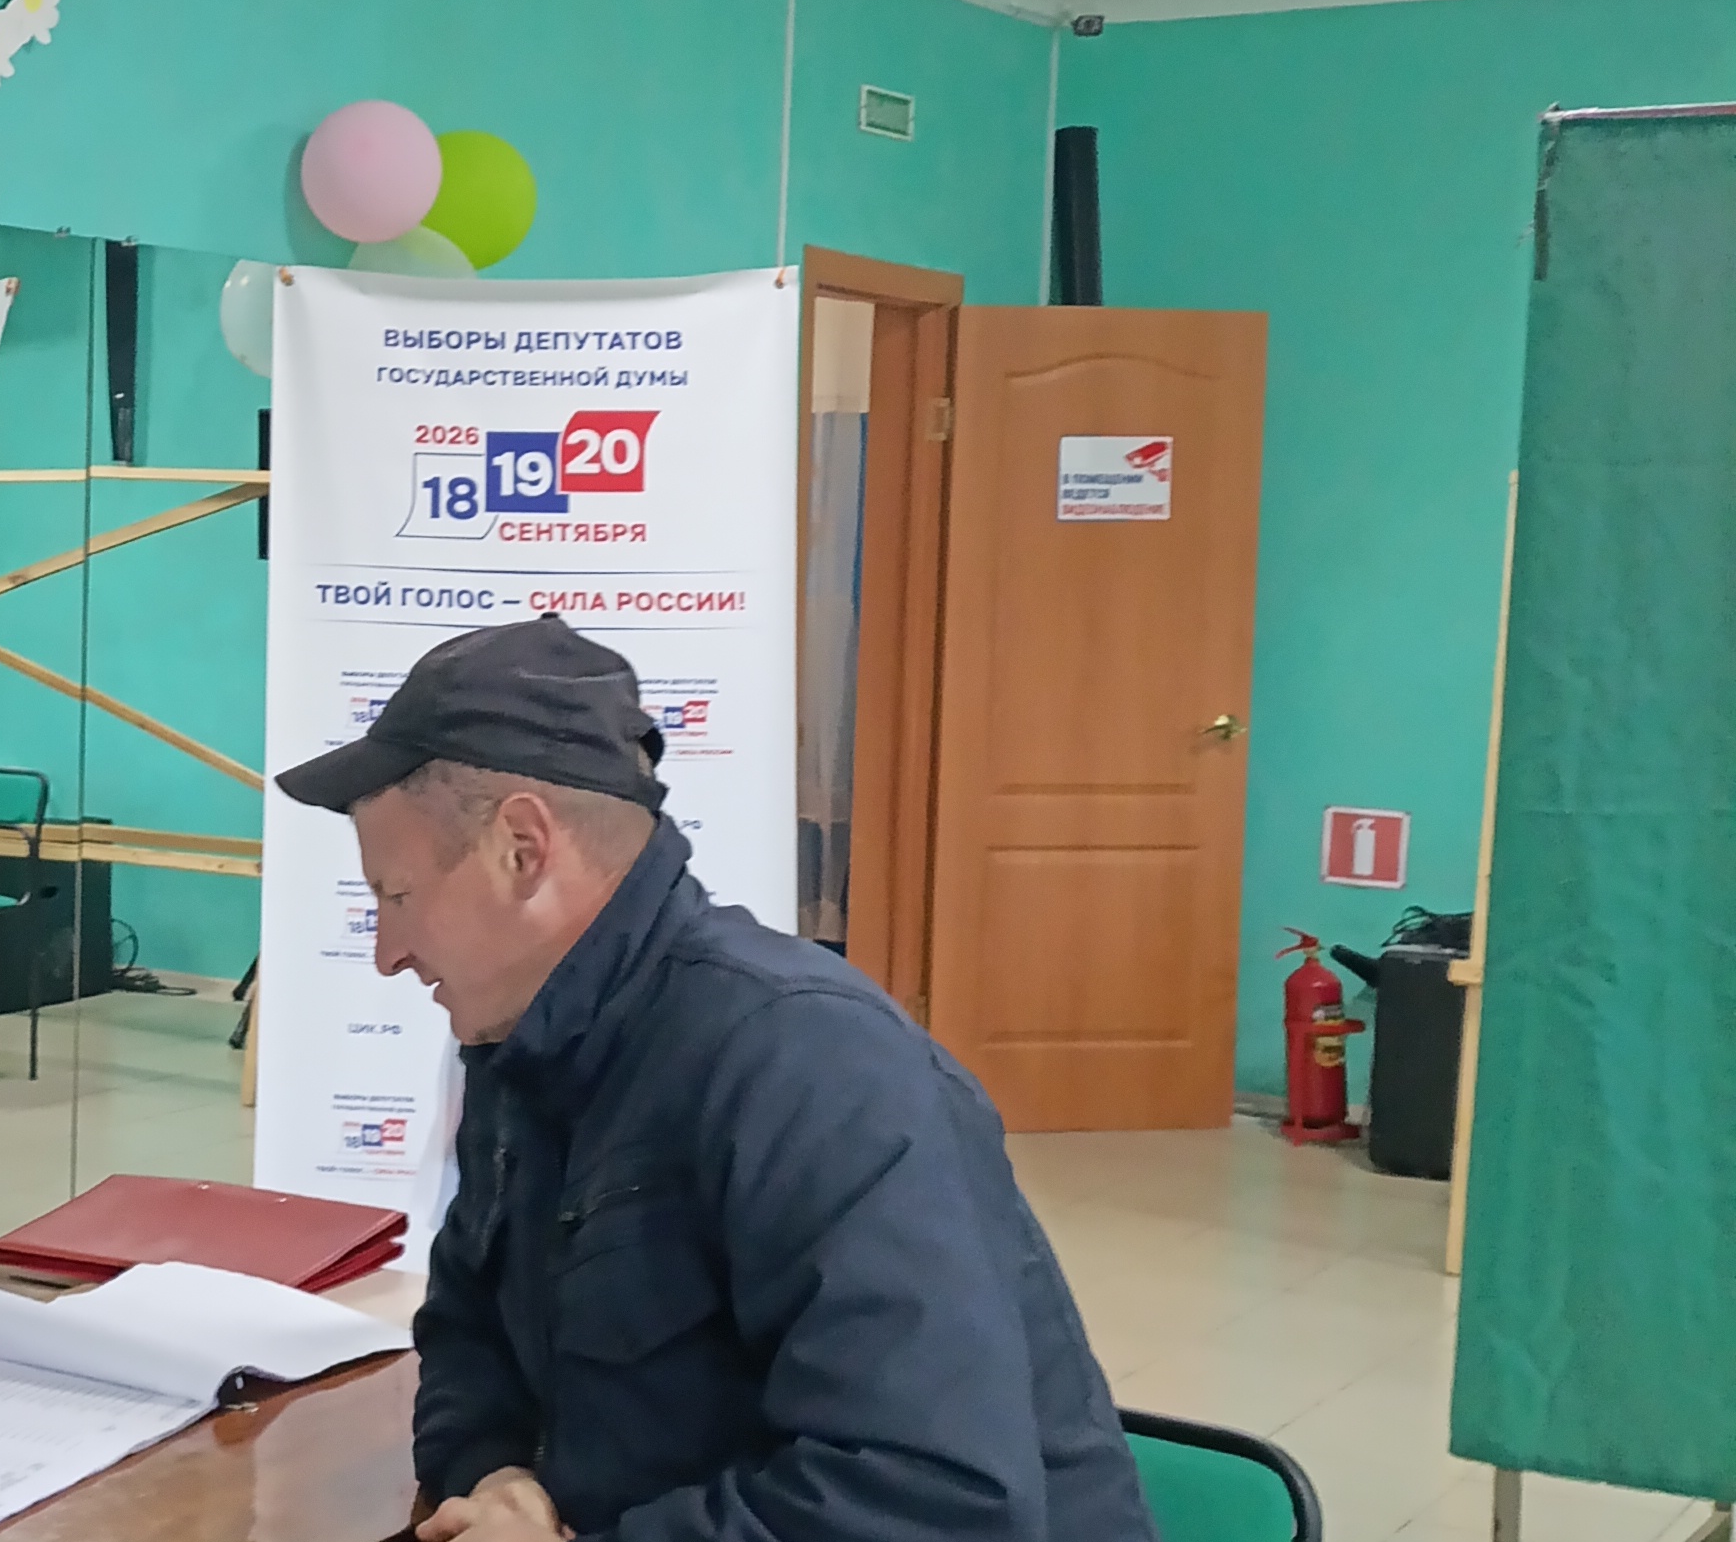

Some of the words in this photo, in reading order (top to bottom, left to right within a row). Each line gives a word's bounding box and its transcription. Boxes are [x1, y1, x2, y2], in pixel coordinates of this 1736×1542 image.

[383, 328, 507, 351] ВЫБОРЫ
[513, 330, 683, 354] ДЕПУТАТОВ
[376, 365, 610, 389] ГОСУДАРСТВЕННОЙ
[614, 368, 689, 390] ДУМЫ
[414, 424, 480, 446] 2026
[421, 476, 480, 521] 18
[492, 451, 554, 497] 19
[565, 428, 641, 475] 20
[498, 521, 647, 543] СЕНТЯБРЯ
[314, 580, 392, 607] ТВОЙ
[400, 587, 495, 610] ГОЛОС
[528, 591, 608, 613] СИЛА
[616, 591, 746, 613] РОССИИ!
